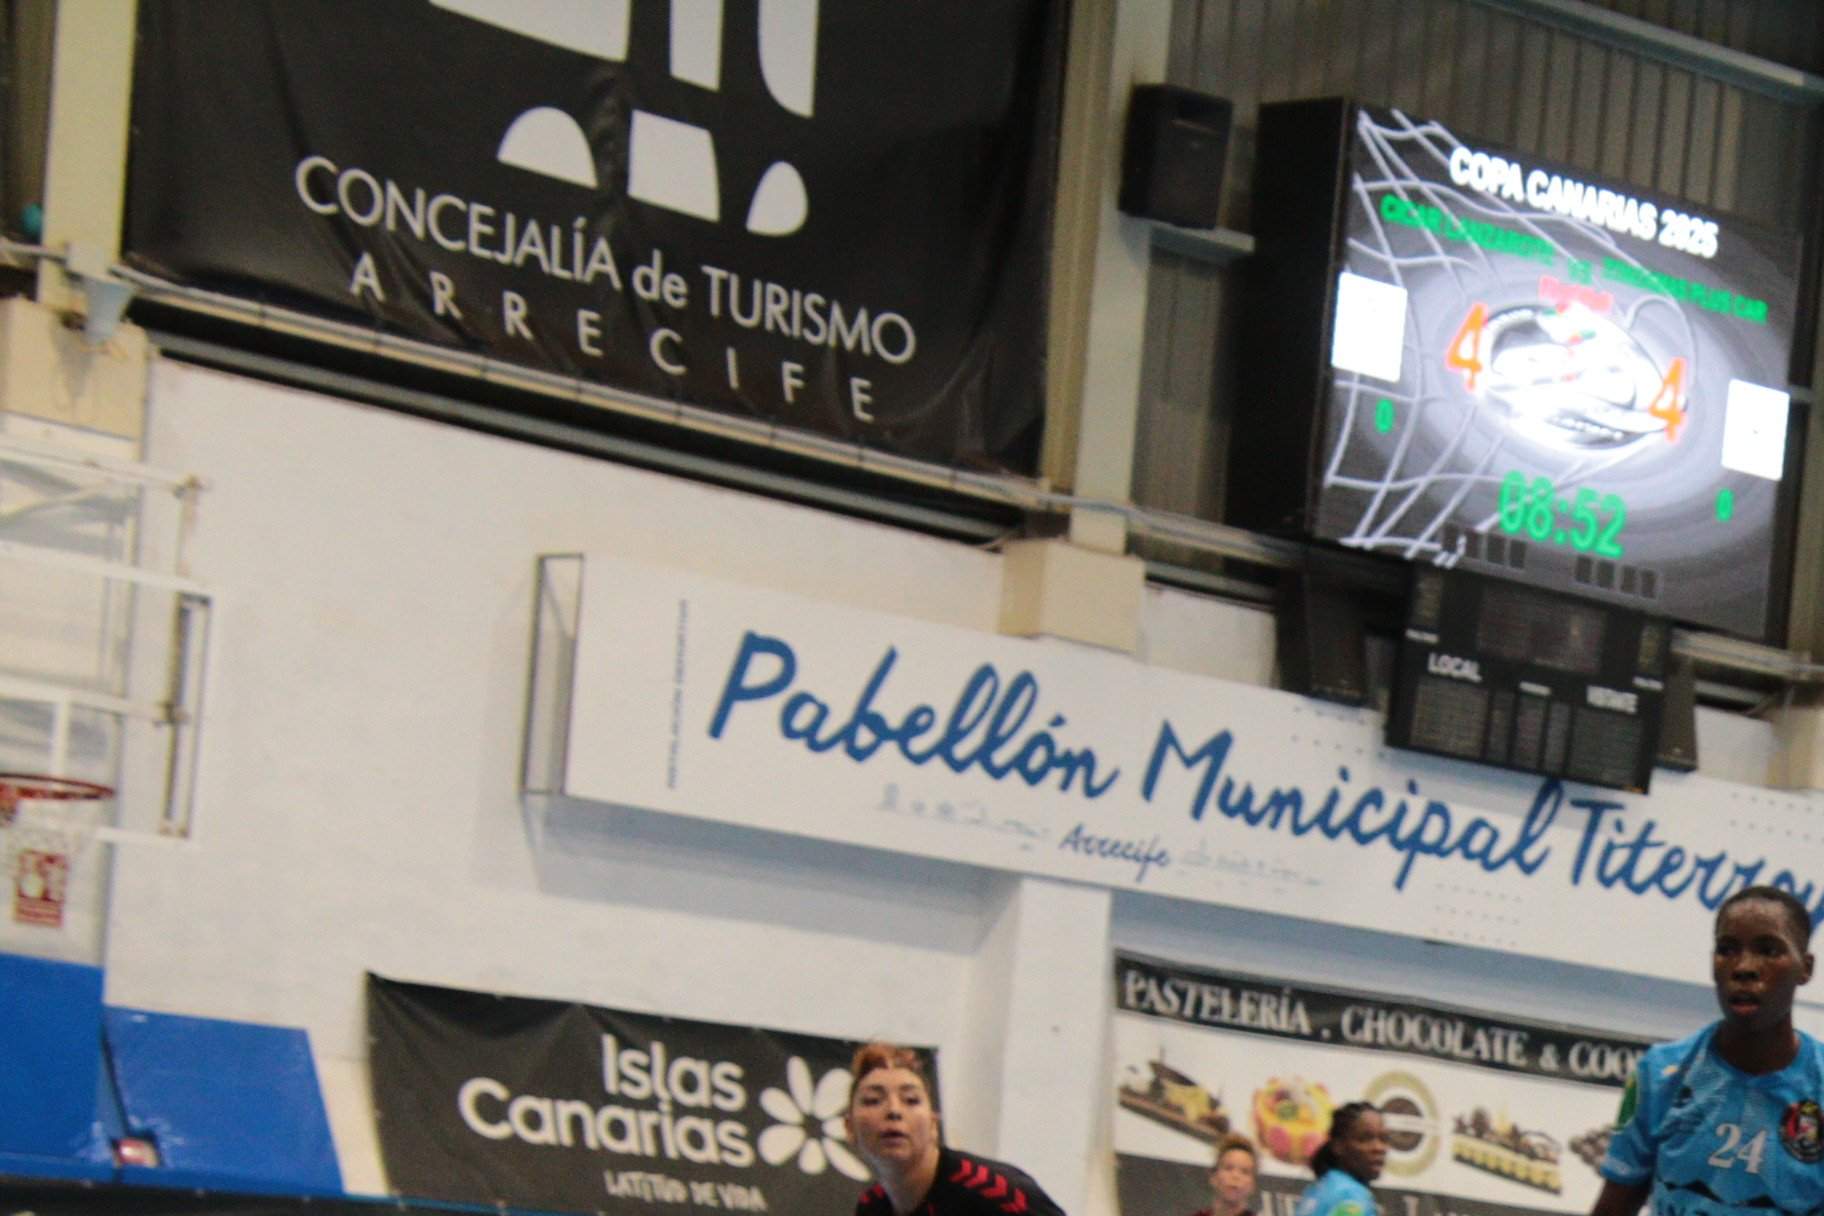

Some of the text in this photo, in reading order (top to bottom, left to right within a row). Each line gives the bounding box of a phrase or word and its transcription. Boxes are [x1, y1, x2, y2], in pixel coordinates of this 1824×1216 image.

[1449, 146, 1523, 197] COPA
[1526, 169, 1657, 240] CANARIAS
[295, 155, 916, 364] CONCEJALÍA de TURISMO
[350, 252, 875, 423] ARRECIFE
[1447, 303, 1489, 392] 4
[1648, 356, 1688, 442] 4
[1500, 470, 1627, 558] 08:52
[1428, 651, 1482, 684] LOCAL
[708, 629, 1121, 799] Pabellón
[1142, 718, 1552, 892] Municipal
[1058, 823, 1171, 884] Arrecife
[1124, 968, 1312, 1036] PASTELERÍA
[1340, 1004, 1527, 1067] CHOCOLATE
[1539, 1042, 1561, 1072] &
[601, 1032, 748, 1113] Islas
[458, 1076, 756, 1169] Canarias
[1707, 1122, 1768, 1174] 24
